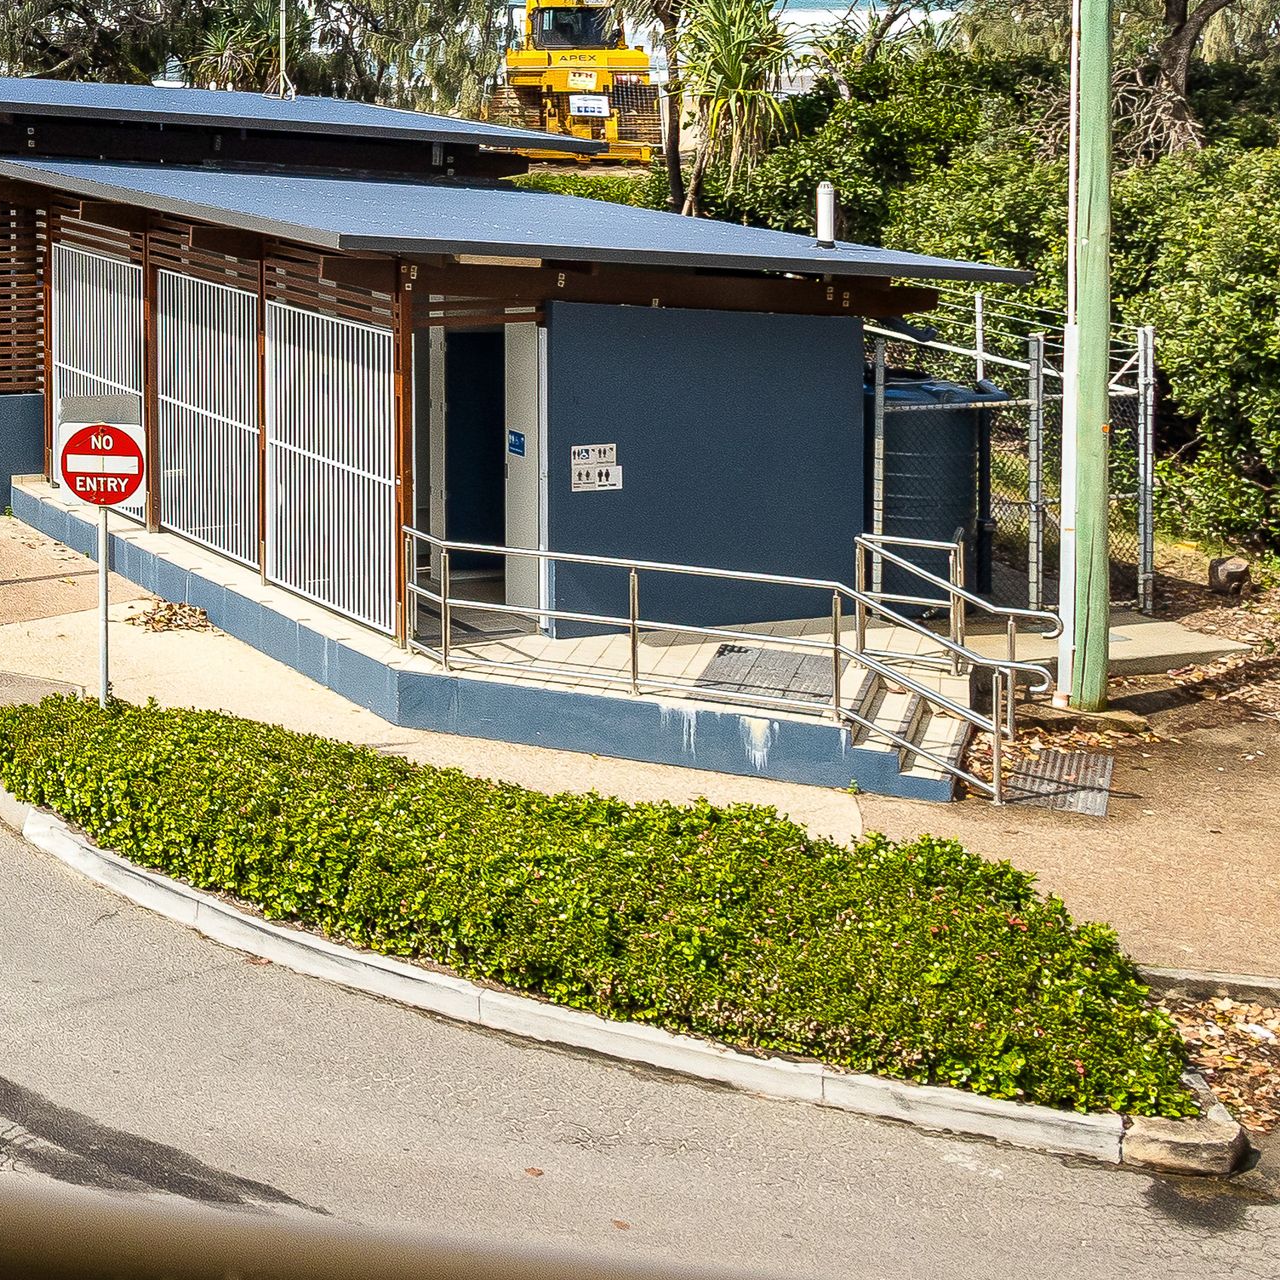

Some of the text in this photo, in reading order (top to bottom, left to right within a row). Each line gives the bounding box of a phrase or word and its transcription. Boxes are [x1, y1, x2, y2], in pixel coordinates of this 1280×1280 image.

[559, 54, 598, 63] APEX
[91, 434, 114, 451] NO
[75, 476, 129, 493] ENTRY
